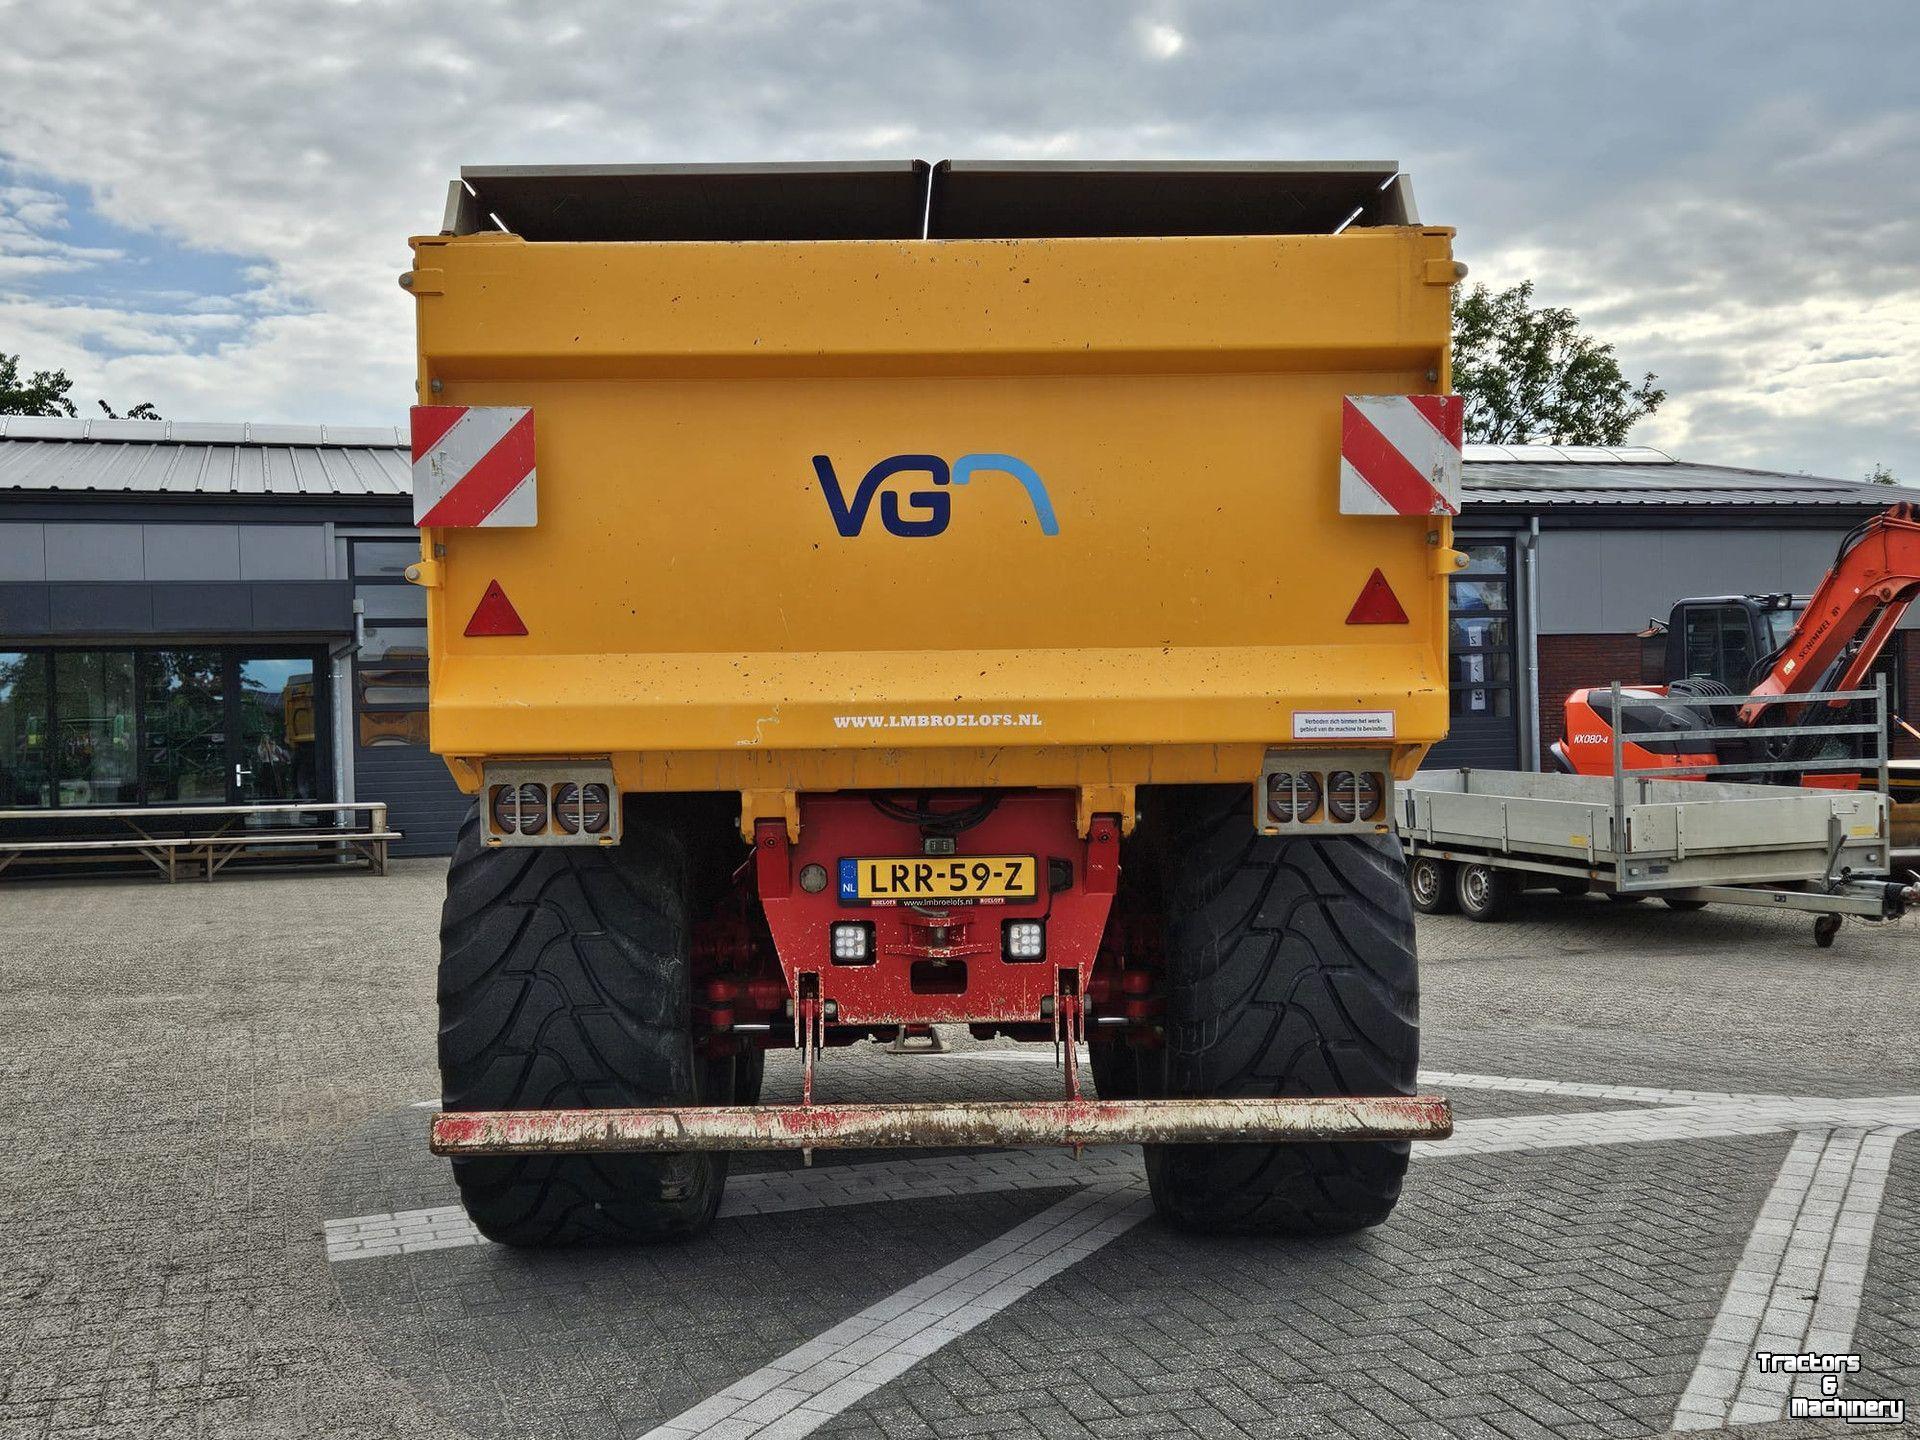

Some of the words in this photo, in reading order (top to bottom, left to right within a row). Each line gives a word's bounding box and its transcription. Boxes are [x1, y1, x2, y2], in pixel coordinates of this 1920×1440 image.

[812, 455, 950, 537] VG
[834, 714, 1043, 728] WWW.LMBROELOFS.NL
[1574, 734, 1608, 744] KX080-4
[870, 862, 1023, 893] LRR-59-Z
[843, 883, 856, 892] NL
